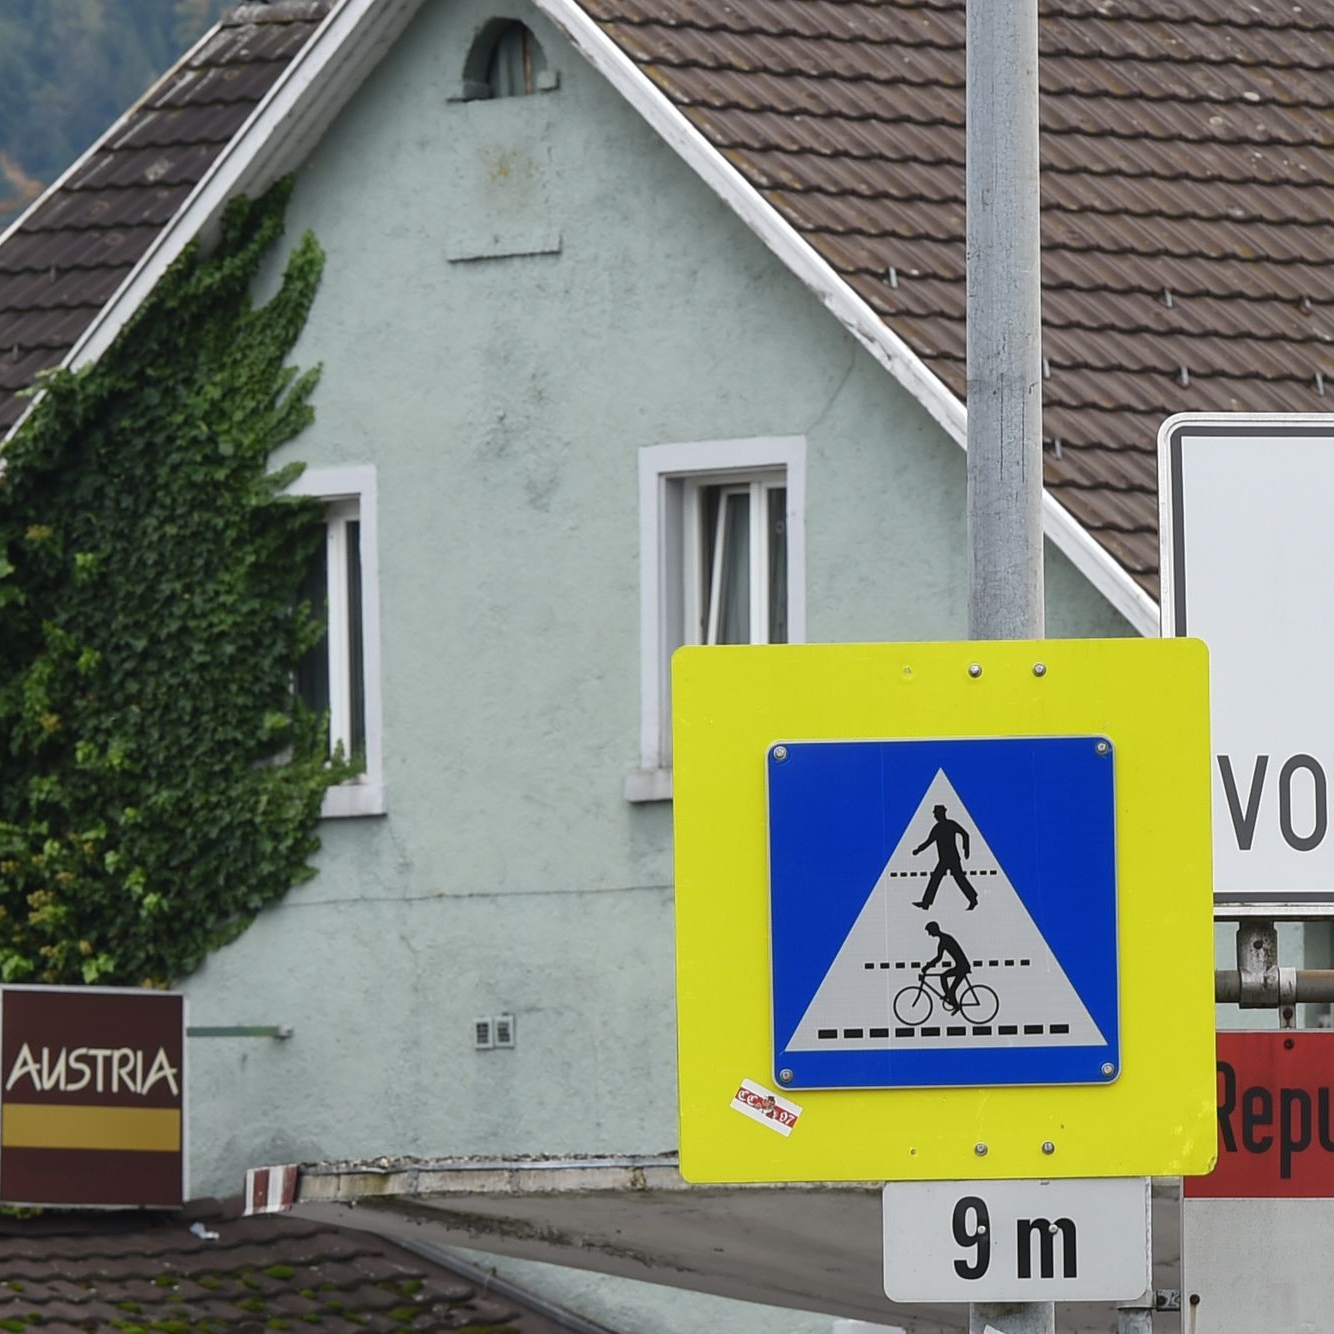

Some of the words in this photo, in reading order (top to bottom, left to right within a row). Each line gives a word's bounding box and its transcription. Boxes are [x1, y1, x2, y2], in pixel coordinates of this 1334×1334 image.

[5, 1043, 179, 1098] AUSTRIA
[951, 1195, 992, 1280] 9
[1016, 1215, 1078, 1279] m
